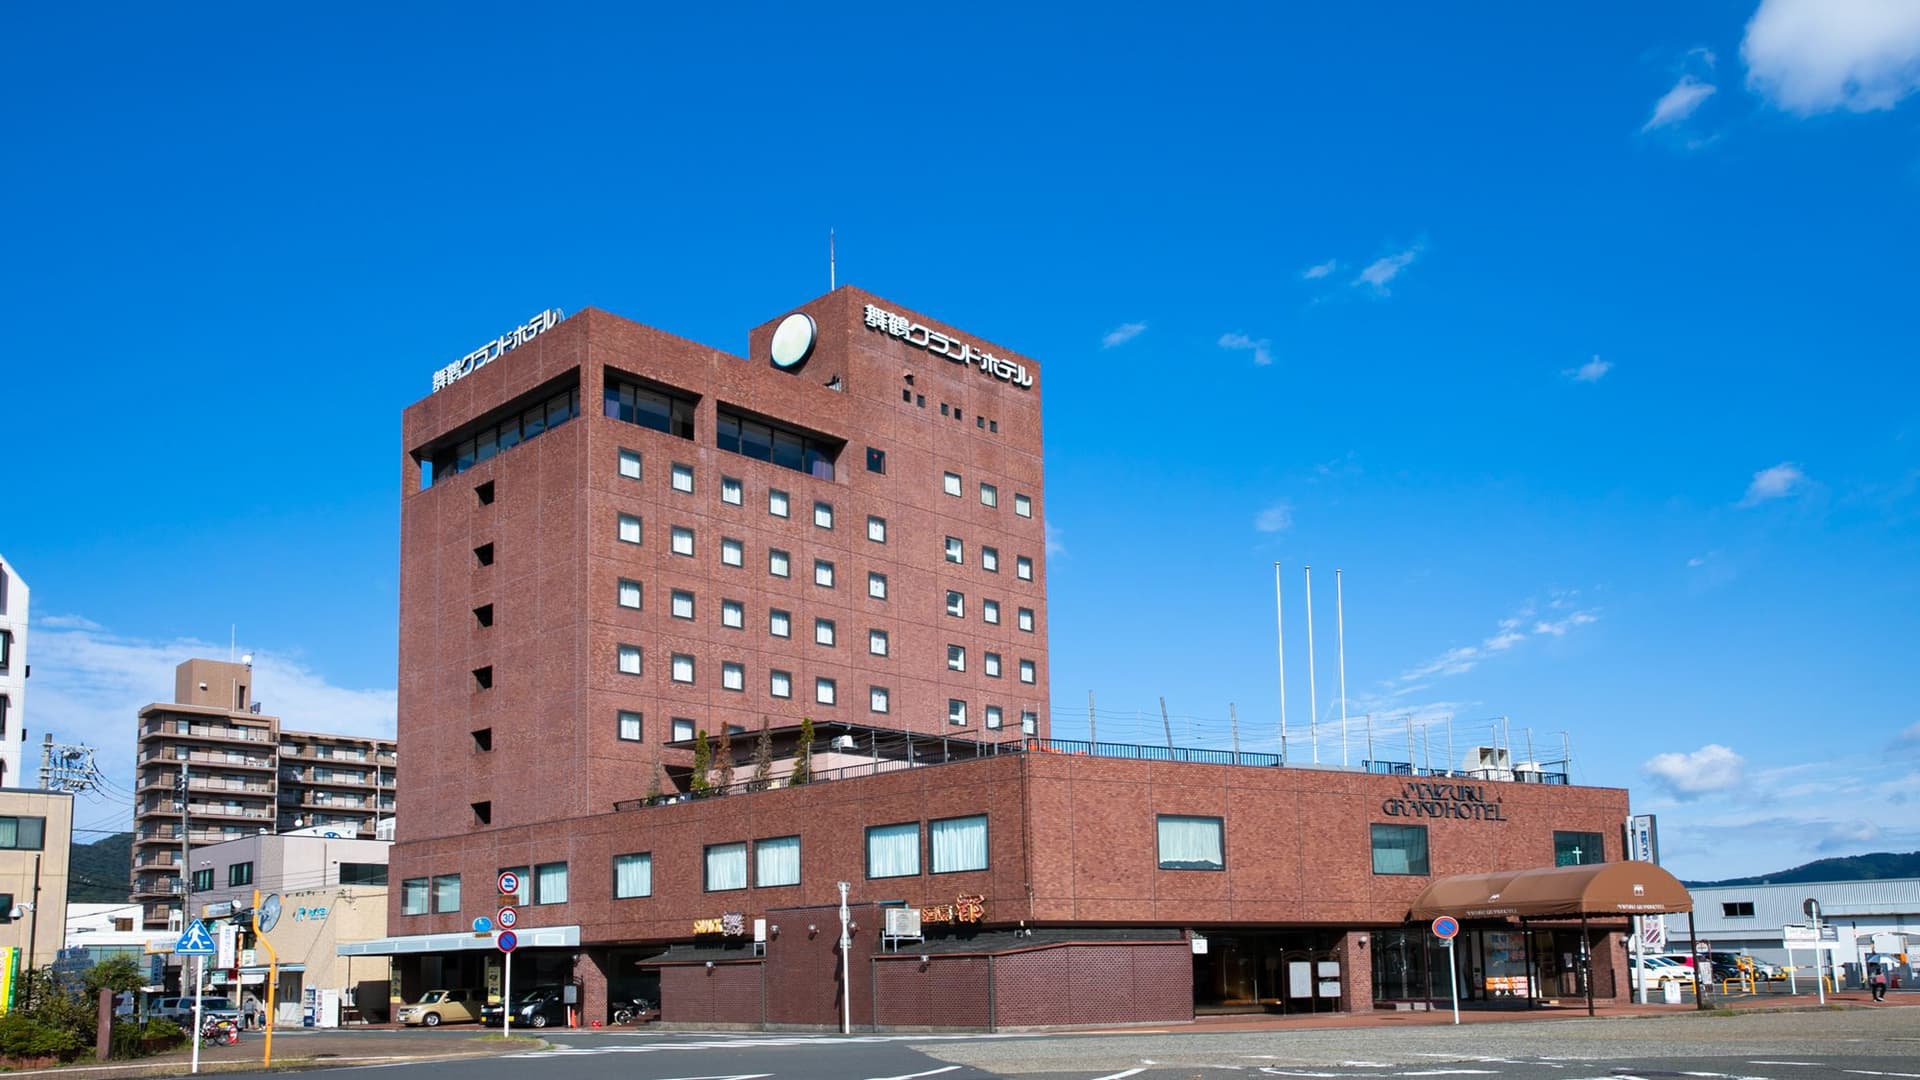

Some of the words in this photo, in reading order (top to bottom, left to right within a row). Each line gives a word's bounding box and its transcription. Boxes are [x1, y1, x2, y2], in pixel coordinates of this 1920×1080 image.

[432, 308, 557, 393] 舞鶴グランドホテル
[864, 303, 1033, 387] 舞鶴グランドホテル
[1406, 782, 1484, 802] MAIZURU
[502, 913, 515, 924] 30
